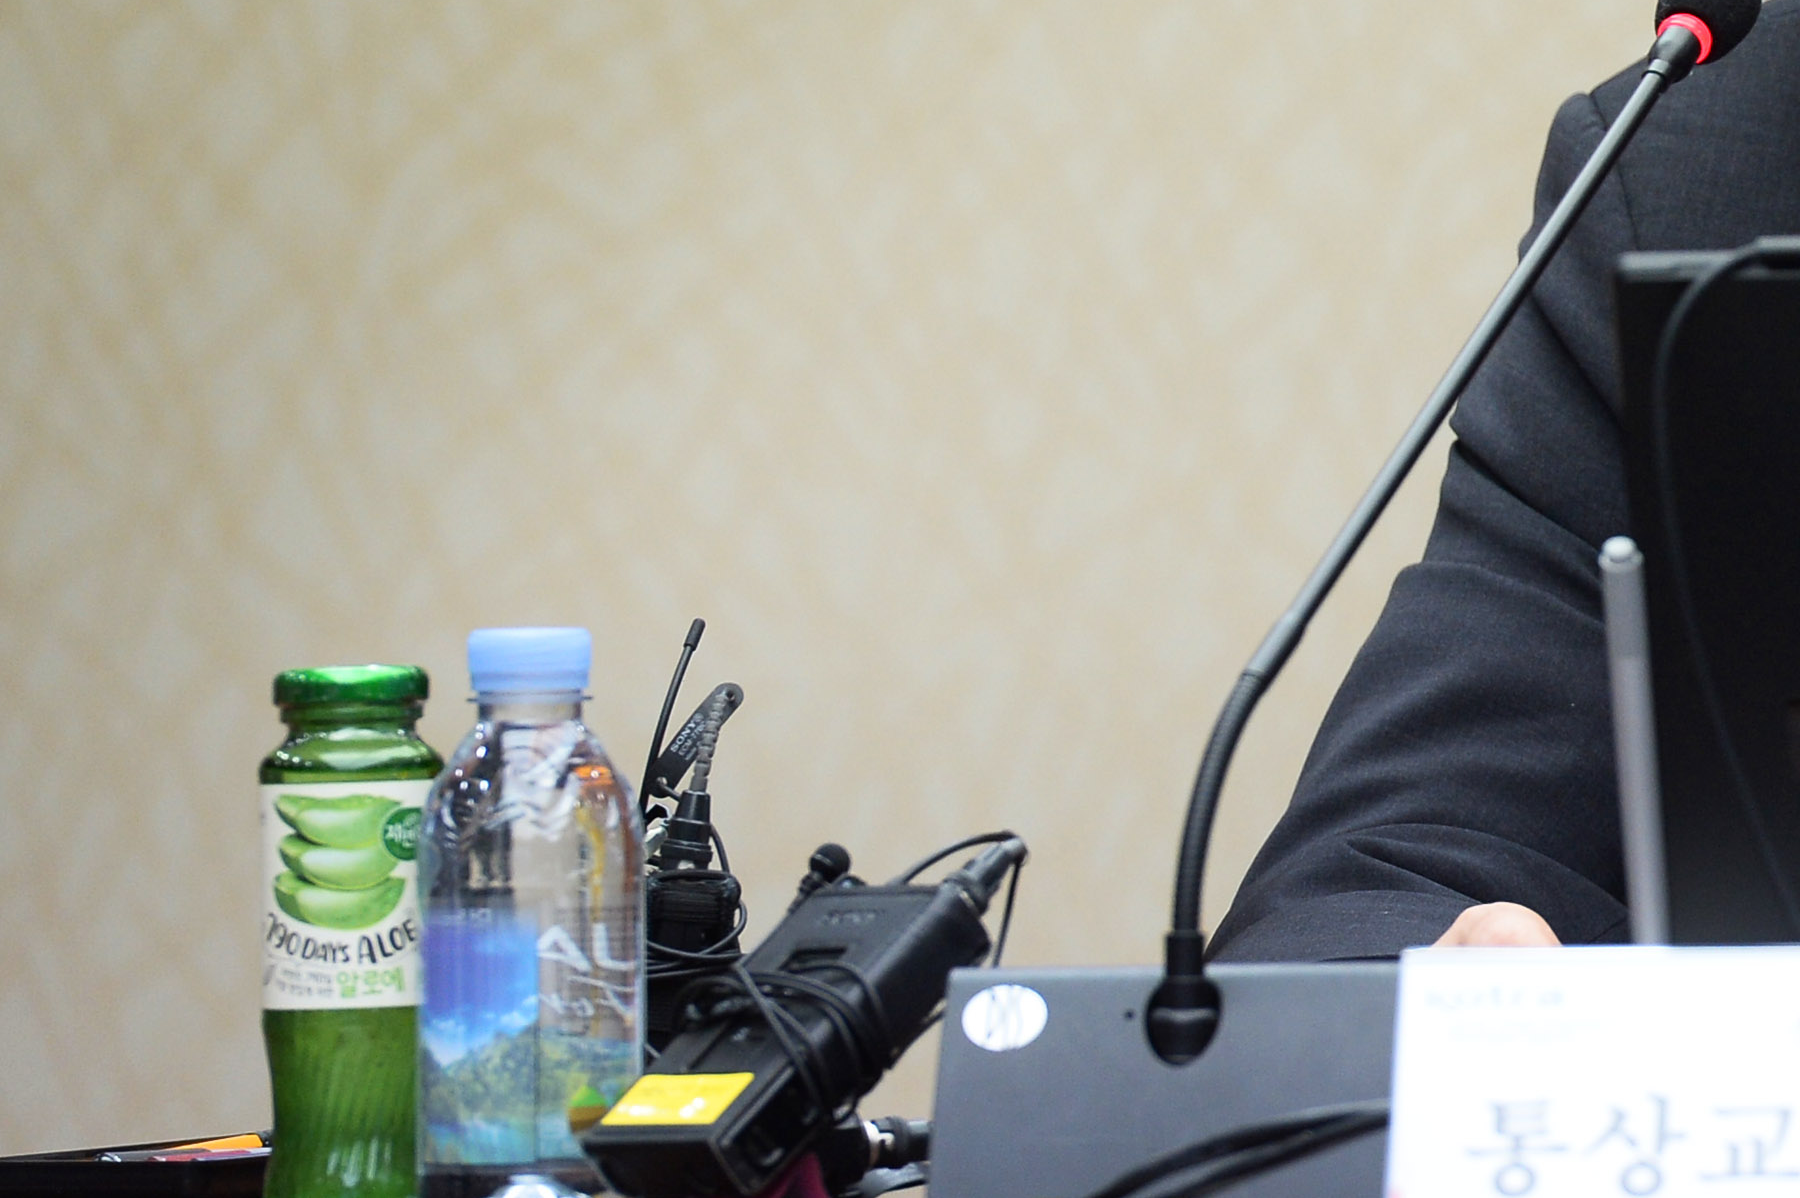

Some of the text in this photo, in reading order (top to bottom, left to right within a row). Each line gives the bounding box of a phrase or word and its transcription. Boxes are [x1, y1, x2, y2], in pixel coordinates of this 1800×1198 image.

[669, 721, 696, 753] SONY
[266, 912, 299, 955] 790
[358, 919, 416, 964] ALOE
